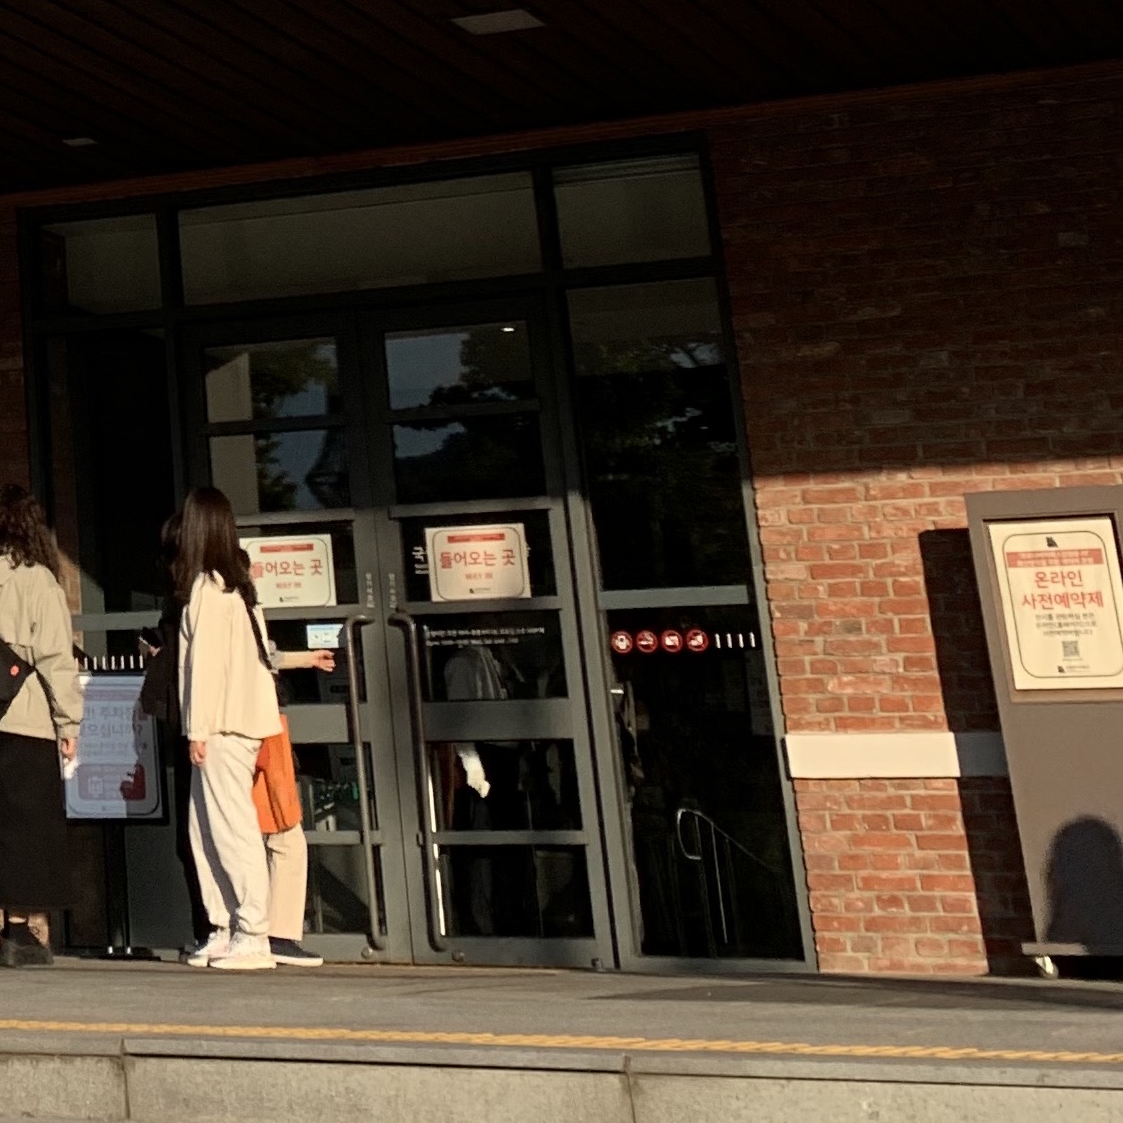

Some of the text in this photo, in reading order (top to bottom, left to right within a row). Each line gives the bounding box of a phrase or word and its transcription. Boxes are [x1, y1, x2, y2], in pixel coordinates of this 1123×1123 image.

[309, 558, 323, 576] 곳
[439, 549, 497, 569] 들어오는
[501, 548, 516, 566] 곳
[1034, 570, 1083, 588] 온라인
[1021, 590, 1104, 610] 사전예약제
